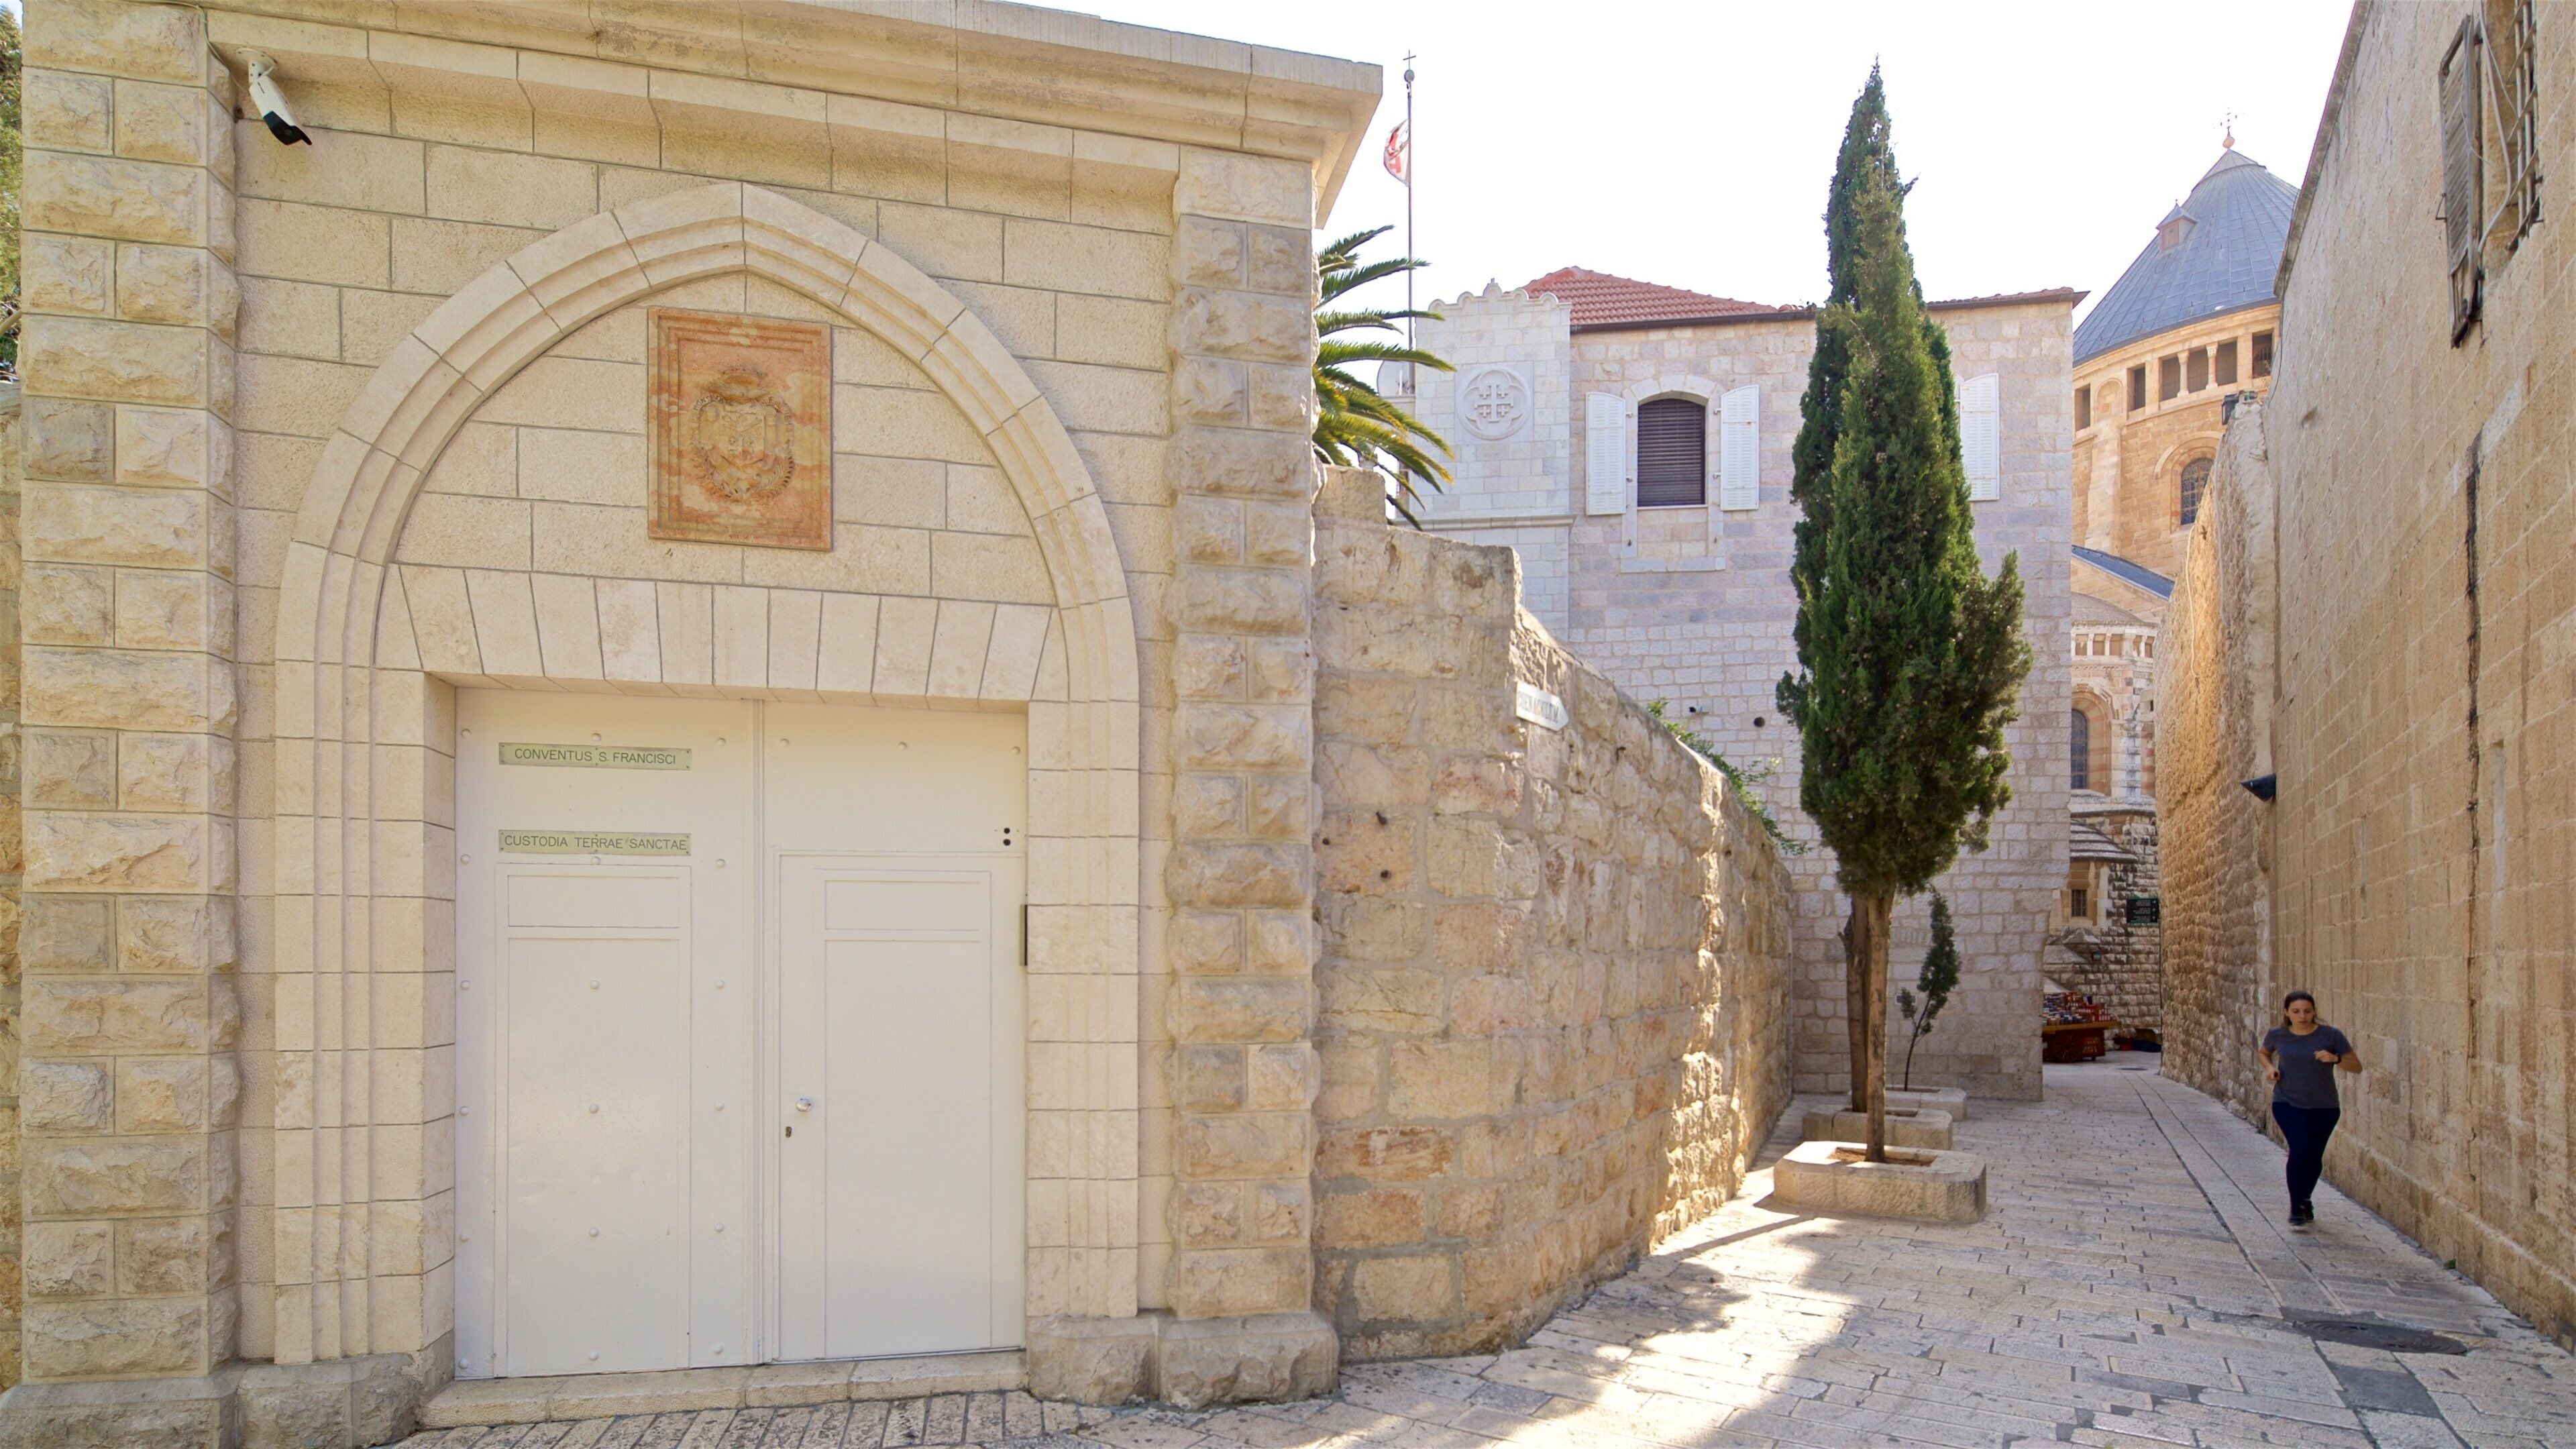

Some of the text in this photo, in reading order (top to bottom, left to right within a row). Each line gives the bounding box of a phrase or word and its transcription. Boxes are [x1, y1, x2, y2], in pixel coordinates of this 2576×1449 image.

[515, 748, 676, 765] CONVENTUS S. FRANCISCI
[504, 835, 687, 851] CUSTODIA TERRAE SANCTAE
